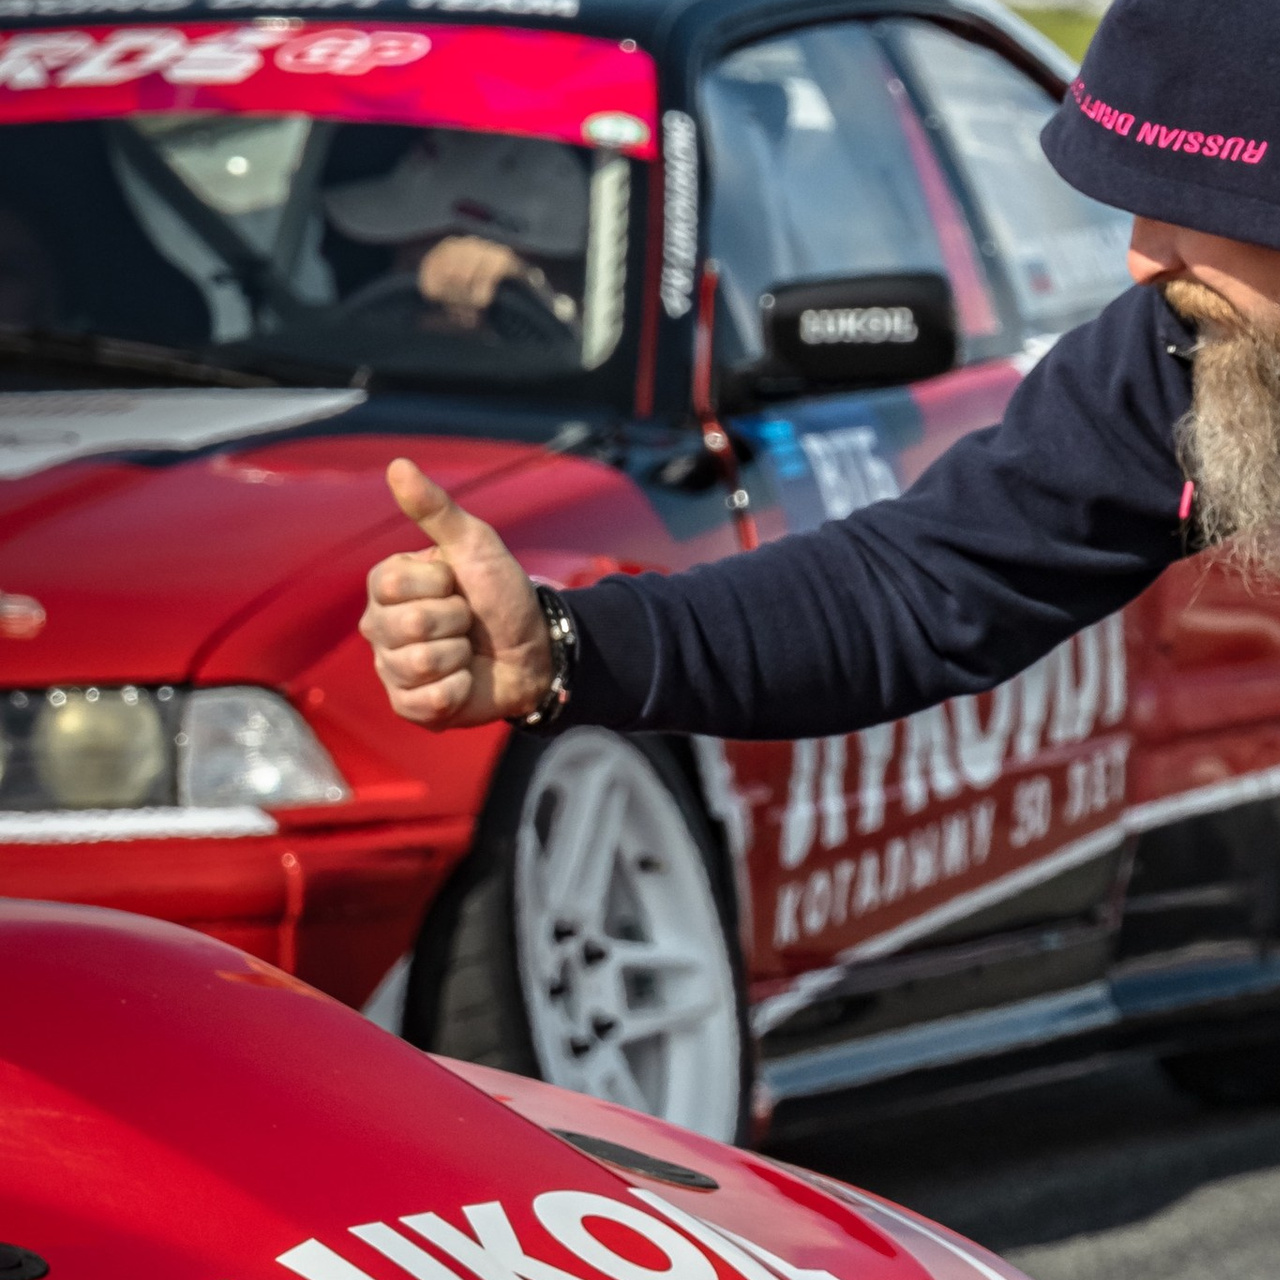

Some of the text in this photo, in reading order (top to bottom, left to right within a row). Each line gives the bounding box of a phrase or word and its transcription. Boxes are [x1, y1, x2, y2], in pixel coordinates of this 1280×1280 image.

[0, 23, 292, 92] RDS
[1079, 93, 1269, 164] RUSSIAN DRIFT
